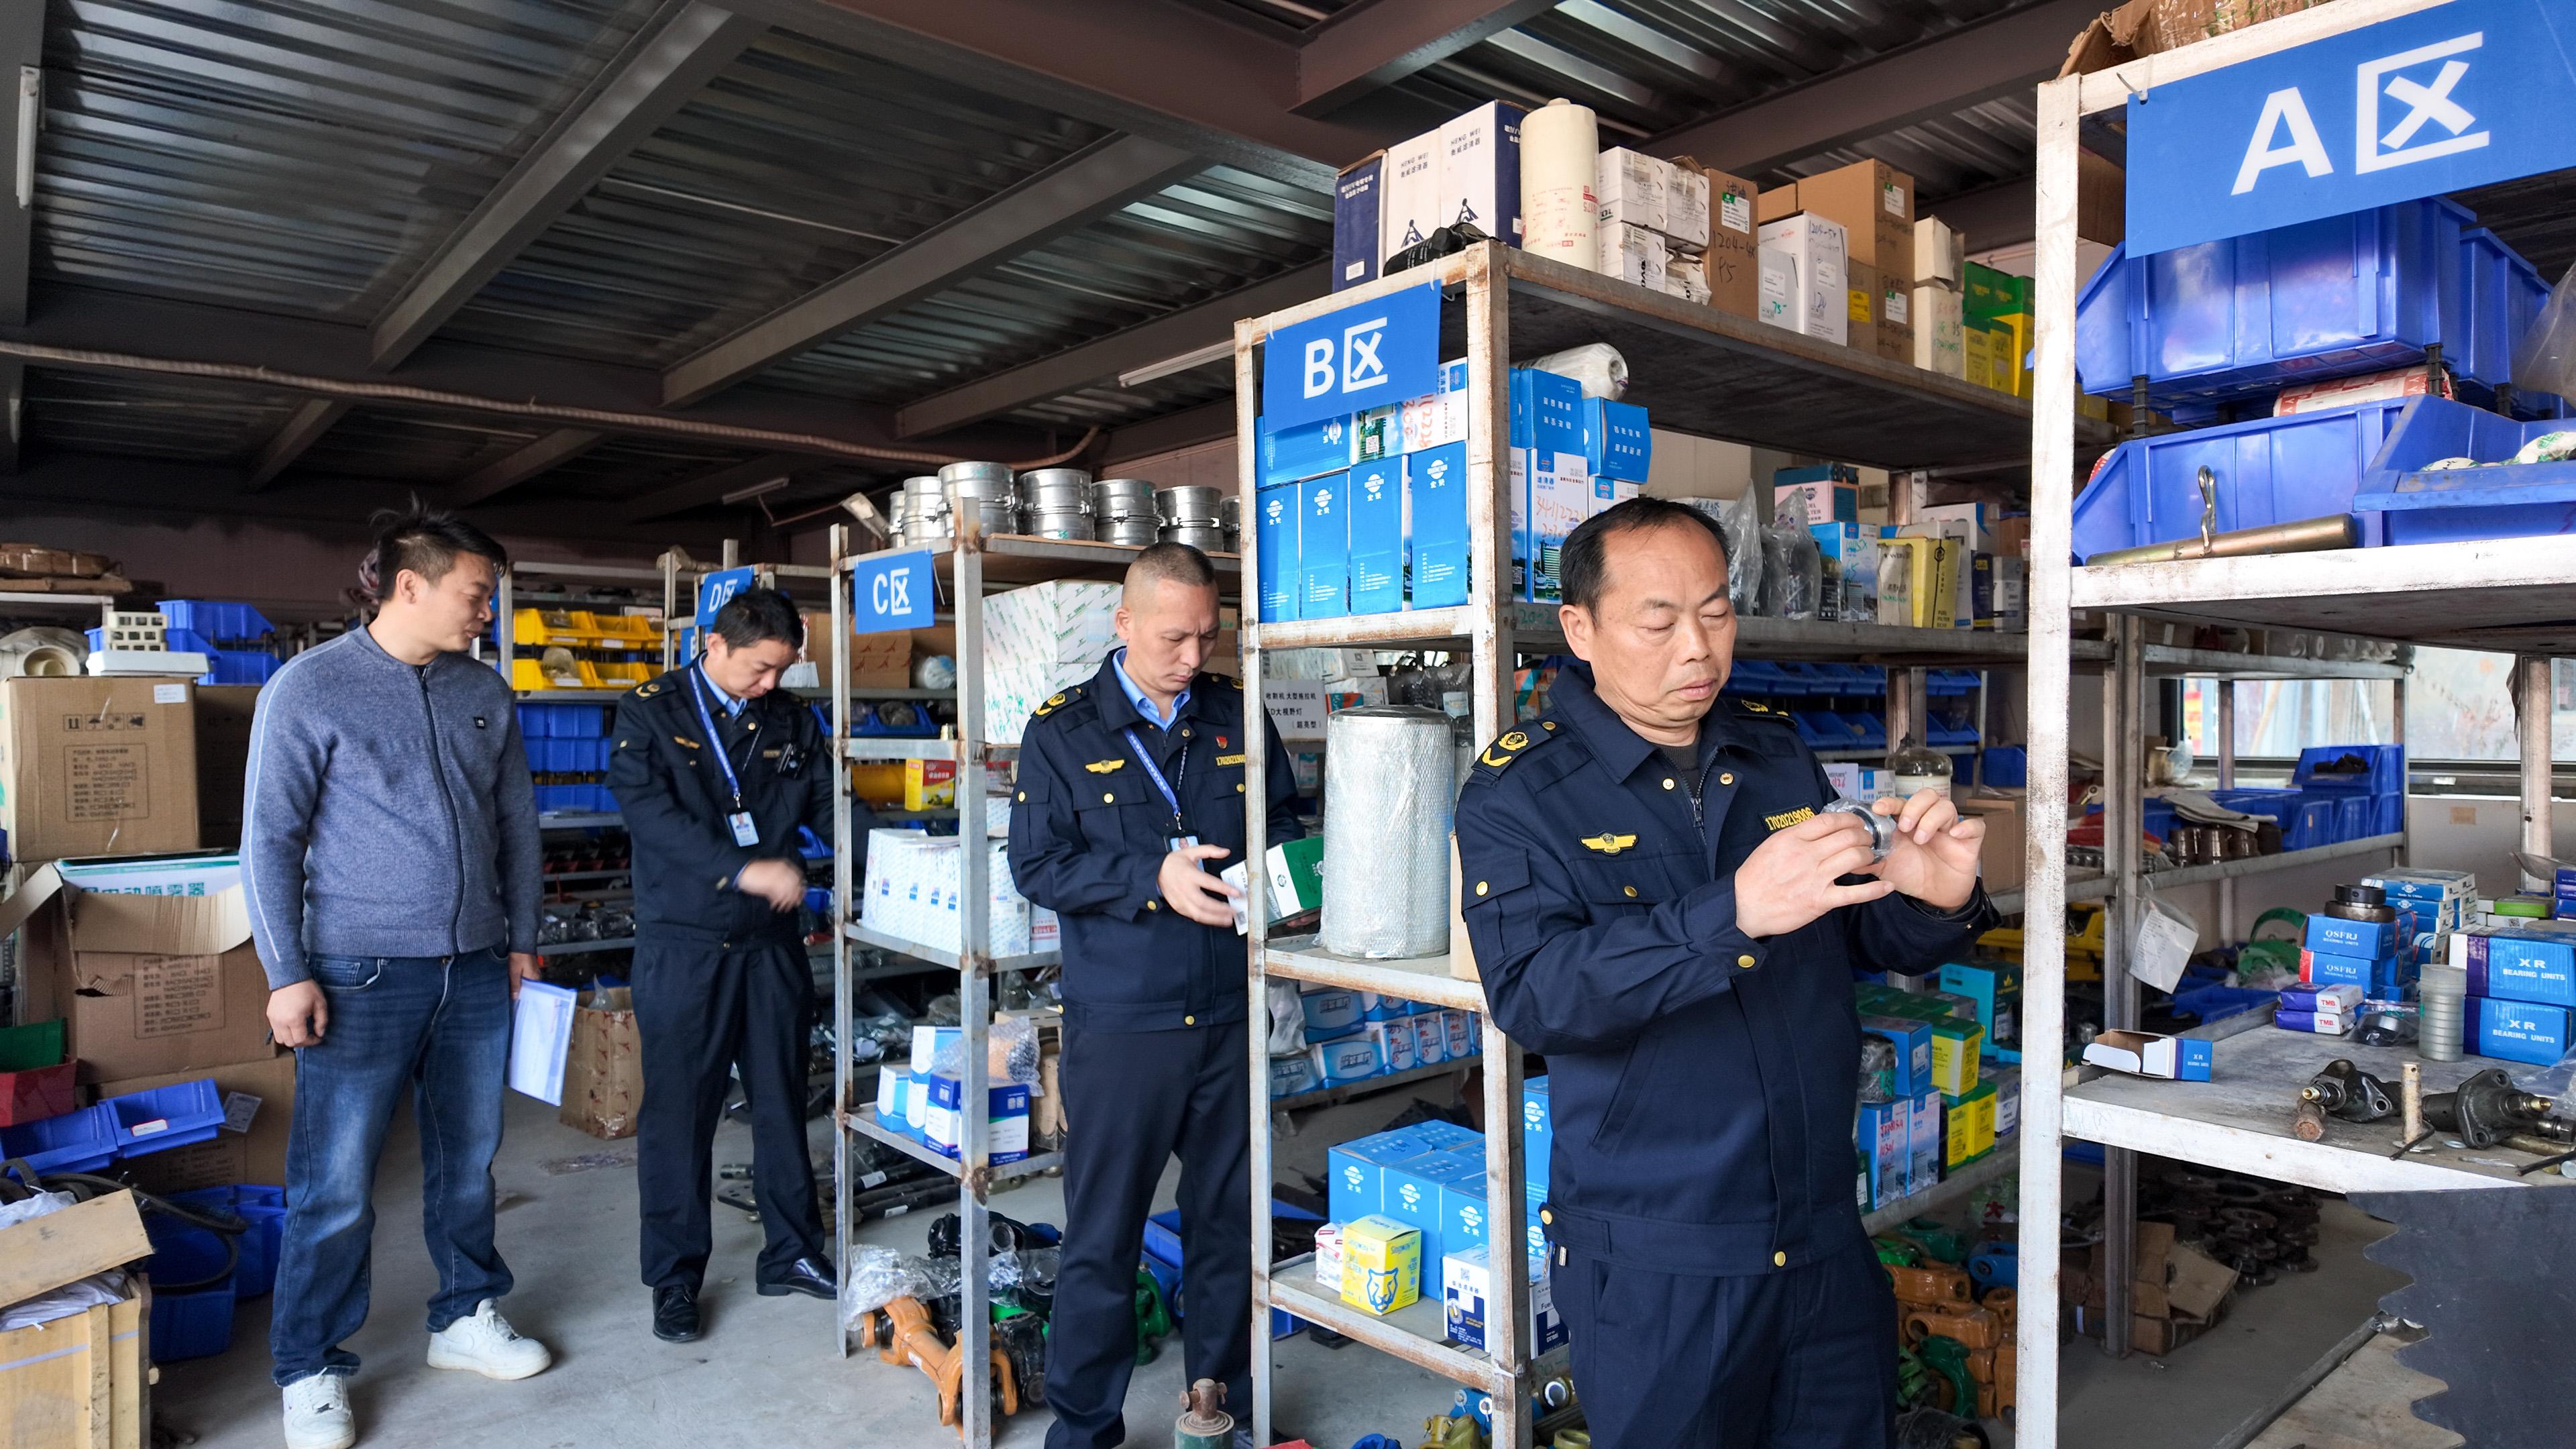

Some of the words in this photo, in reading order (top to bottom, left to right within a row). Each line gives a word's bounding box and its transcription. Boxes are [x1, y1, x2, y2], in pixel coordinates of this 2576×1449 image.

[2231, 32, 2489, 195] A区
[1303, 317, 1388, 399] B区
[873, 568, 912, 616] C区
[2325, 929, 2358, 941] QSFRJ
[2326, 963, 2357, 975] QSFRJ
[2503, 968, 2538, 978] BEARING
[2541, 972, 2566, 981] UNITS
[2320, 999, 2336, 1007] TMB
[2493, 1029, 2527, 1040] BEARING
[2530, 1034, 2555, 1044] UNITS
